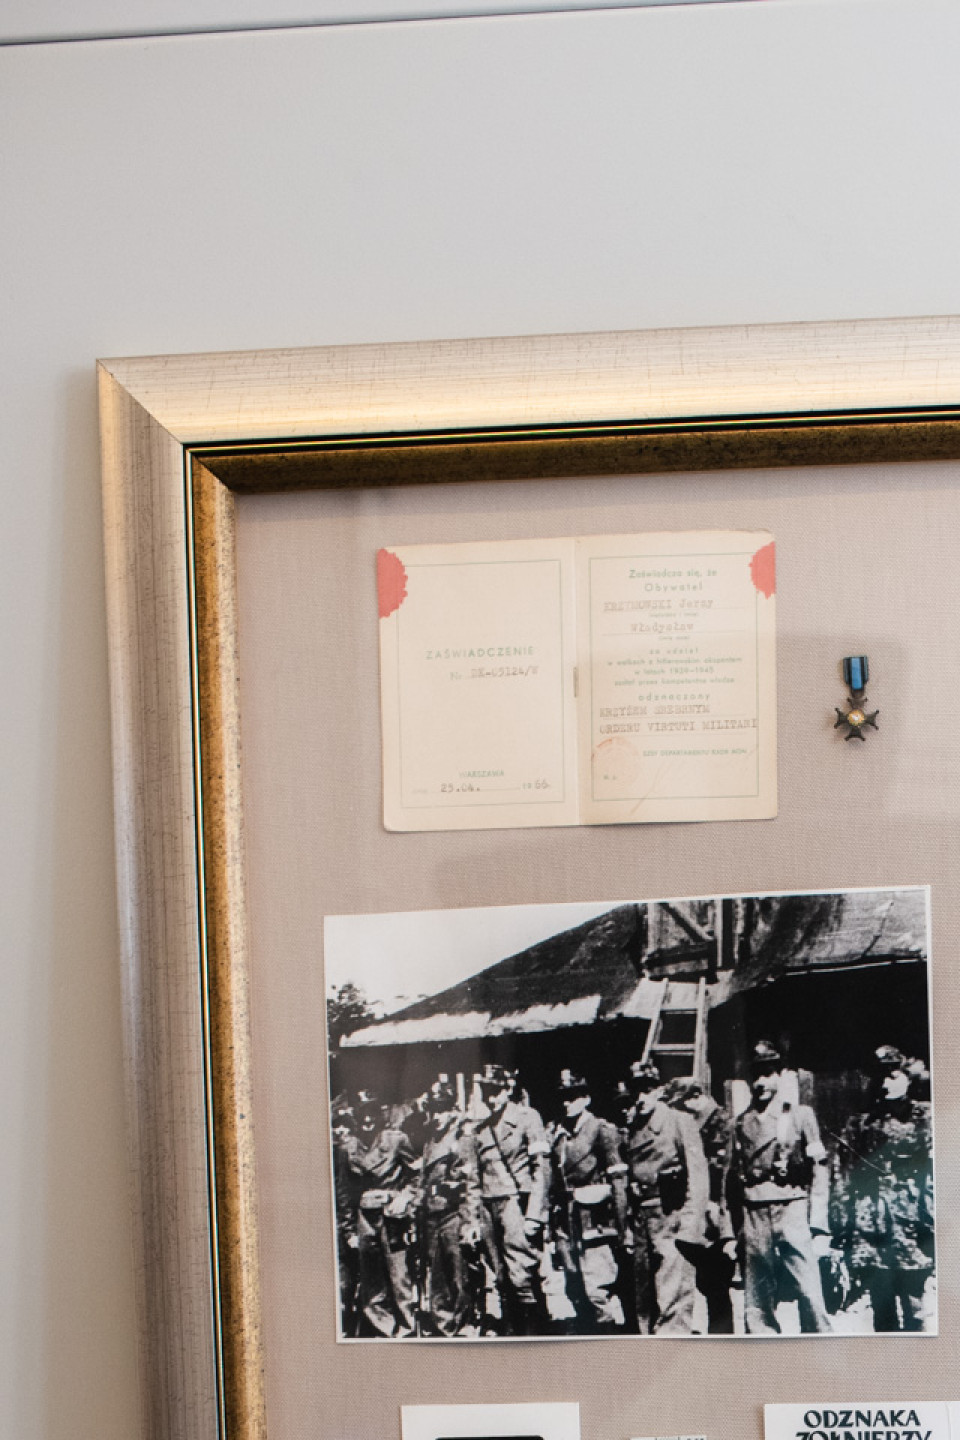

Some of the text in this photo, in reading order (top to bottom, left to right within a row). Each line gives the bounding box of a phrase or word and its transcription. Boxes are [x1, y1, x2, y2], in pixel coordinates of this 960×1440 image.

[644, 583, 703, 592] Obywatel
[425, 646, 534, 660] ZAŚWIADCZENIE
[638, 693, 711, 702] odznaczony
[647, 721, 695, 732] VIRTUTI
[702, 718, 760, 731] MILITARI
[804, 1409, 921, 1429] ODZNAKA
